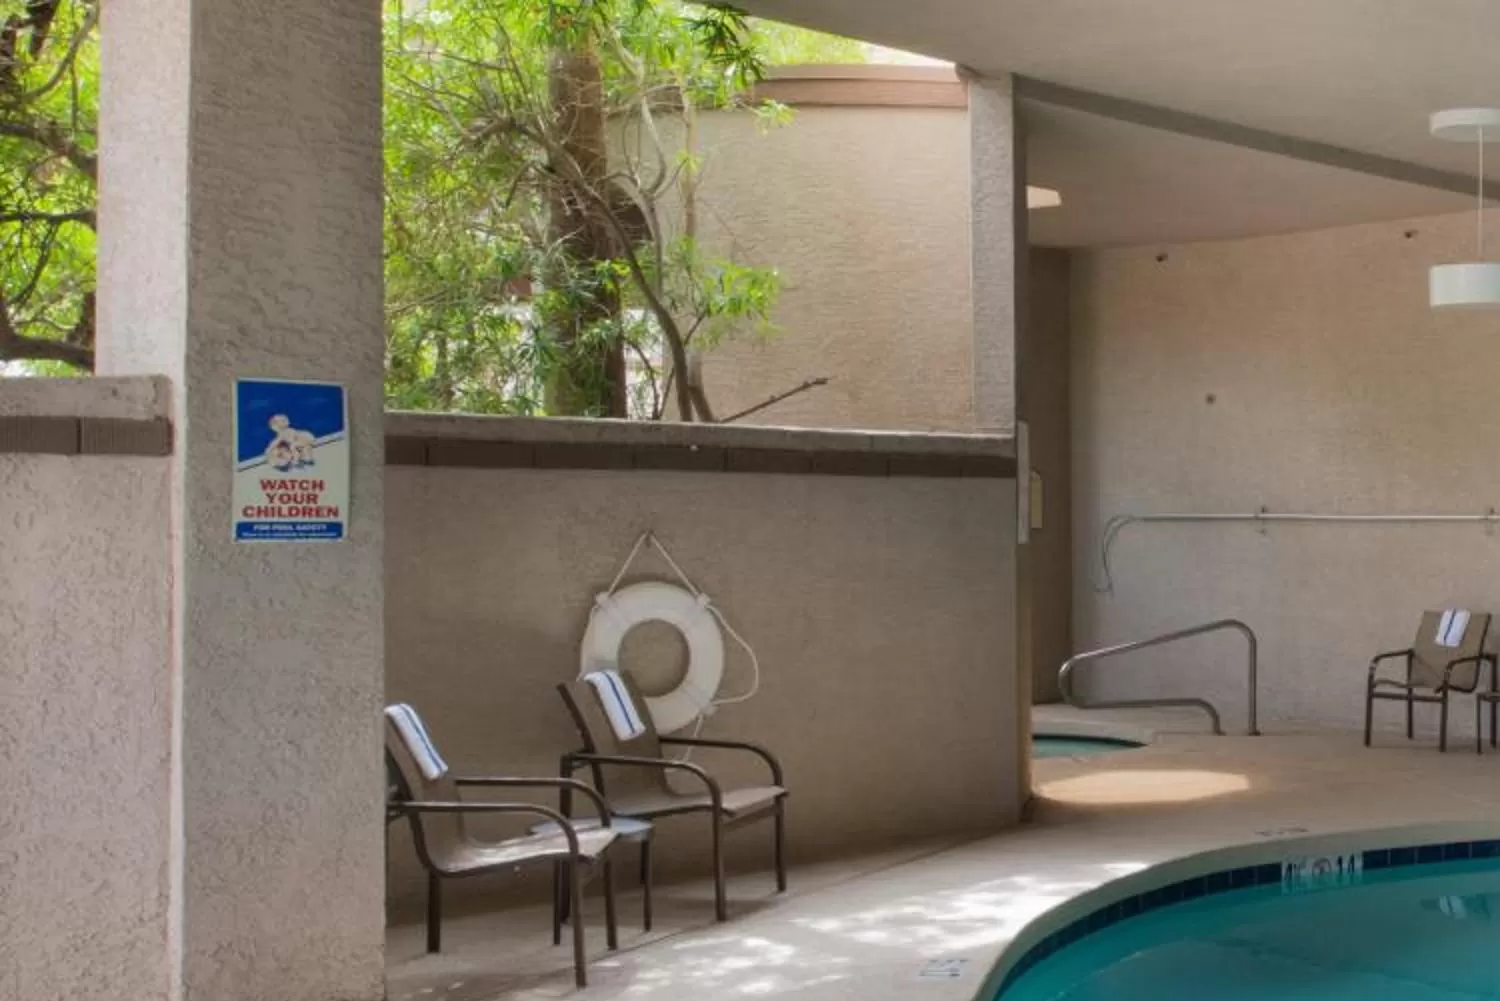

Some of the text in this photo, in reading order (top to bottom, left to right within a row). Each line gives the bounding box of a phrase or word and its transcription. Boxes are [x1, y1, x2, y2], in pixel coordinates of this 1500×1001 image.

[260, 479, 325, 491] WATCH
[266, 492, 319, 505] YOUR
[242, 505, 339, 518] CHILDREN
